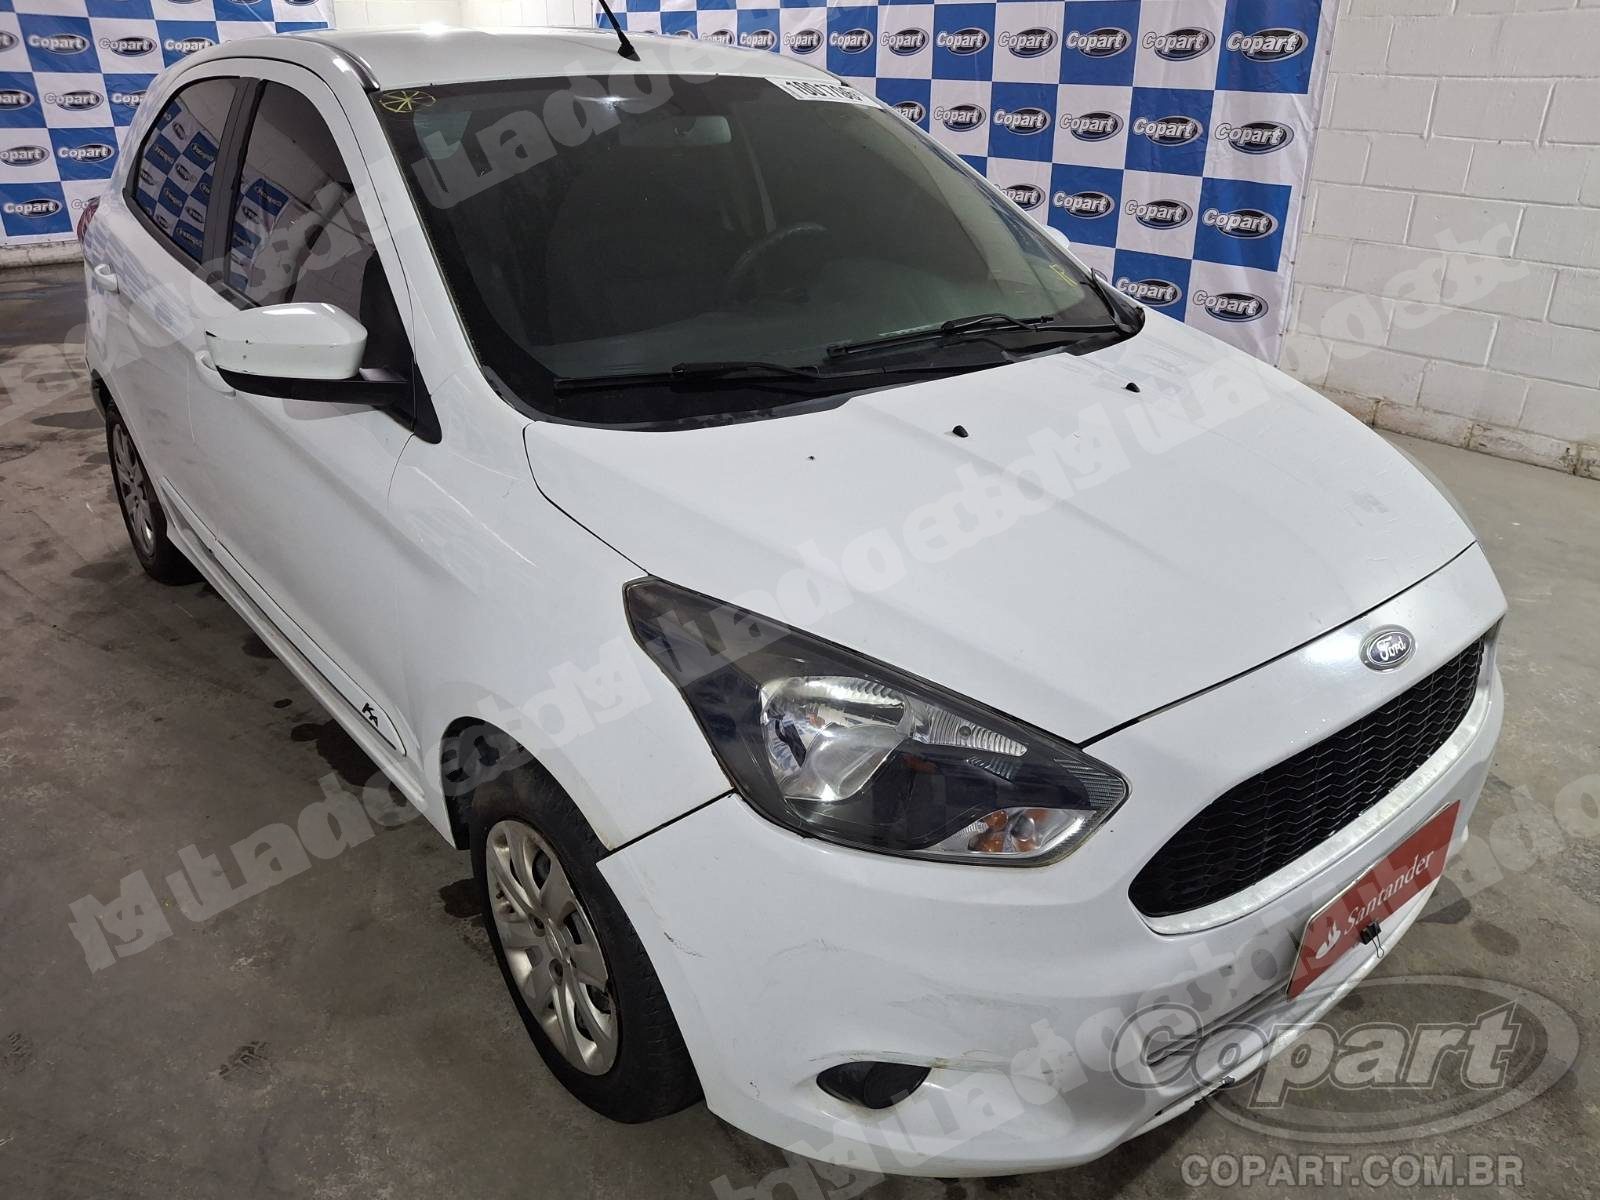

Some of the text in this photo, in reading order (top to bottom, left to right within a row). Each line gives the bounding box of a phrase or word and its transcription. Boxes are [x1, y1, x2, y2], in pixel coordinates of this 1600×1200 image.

[28, 35, 82, 50] Copart
[99, 37, 150, 51] Copart
[739, 33, 773, 47] Copart
[783, 32, 818, 48] Copart
[830, 32, 868, 48] Copart
[880, 31, 922, 48] Copart
[936, 31, 984, 49] Copart
[999, 31, 1051, 50] Copart
[1066, 31, 1124, 52] Copart
[1142, 31, 1208, 54] Copart
[1226, 31, 1300, 56] Copart
[0, 93, 28, 105] art
[44, 92, 96, 106] Copart
[934, 106, 980, 126] Copart
[993, 108, 1046, 130] Copart
[1059, 113, 1115, 134] Copart
[1133, 117, 1195, 140] Copart
[1215, 122, 1283, 146] Copart
[0, 148, 41, 162] opart
[59, 146, 108, 160] Copart
[4, 201, 55, 216] Copart
[1053, 191, 1109, 213] Copart
[1125, 199, 1184, 222] Copart
[1202, 207, 1269, 232] Copart
[1115, 276, 1175, 301] Copart
[1193, 289, 1260, 316] Copart
[1376, 634, 1407, 661] Ford
[1343, 850, 1435, 936] Santander
